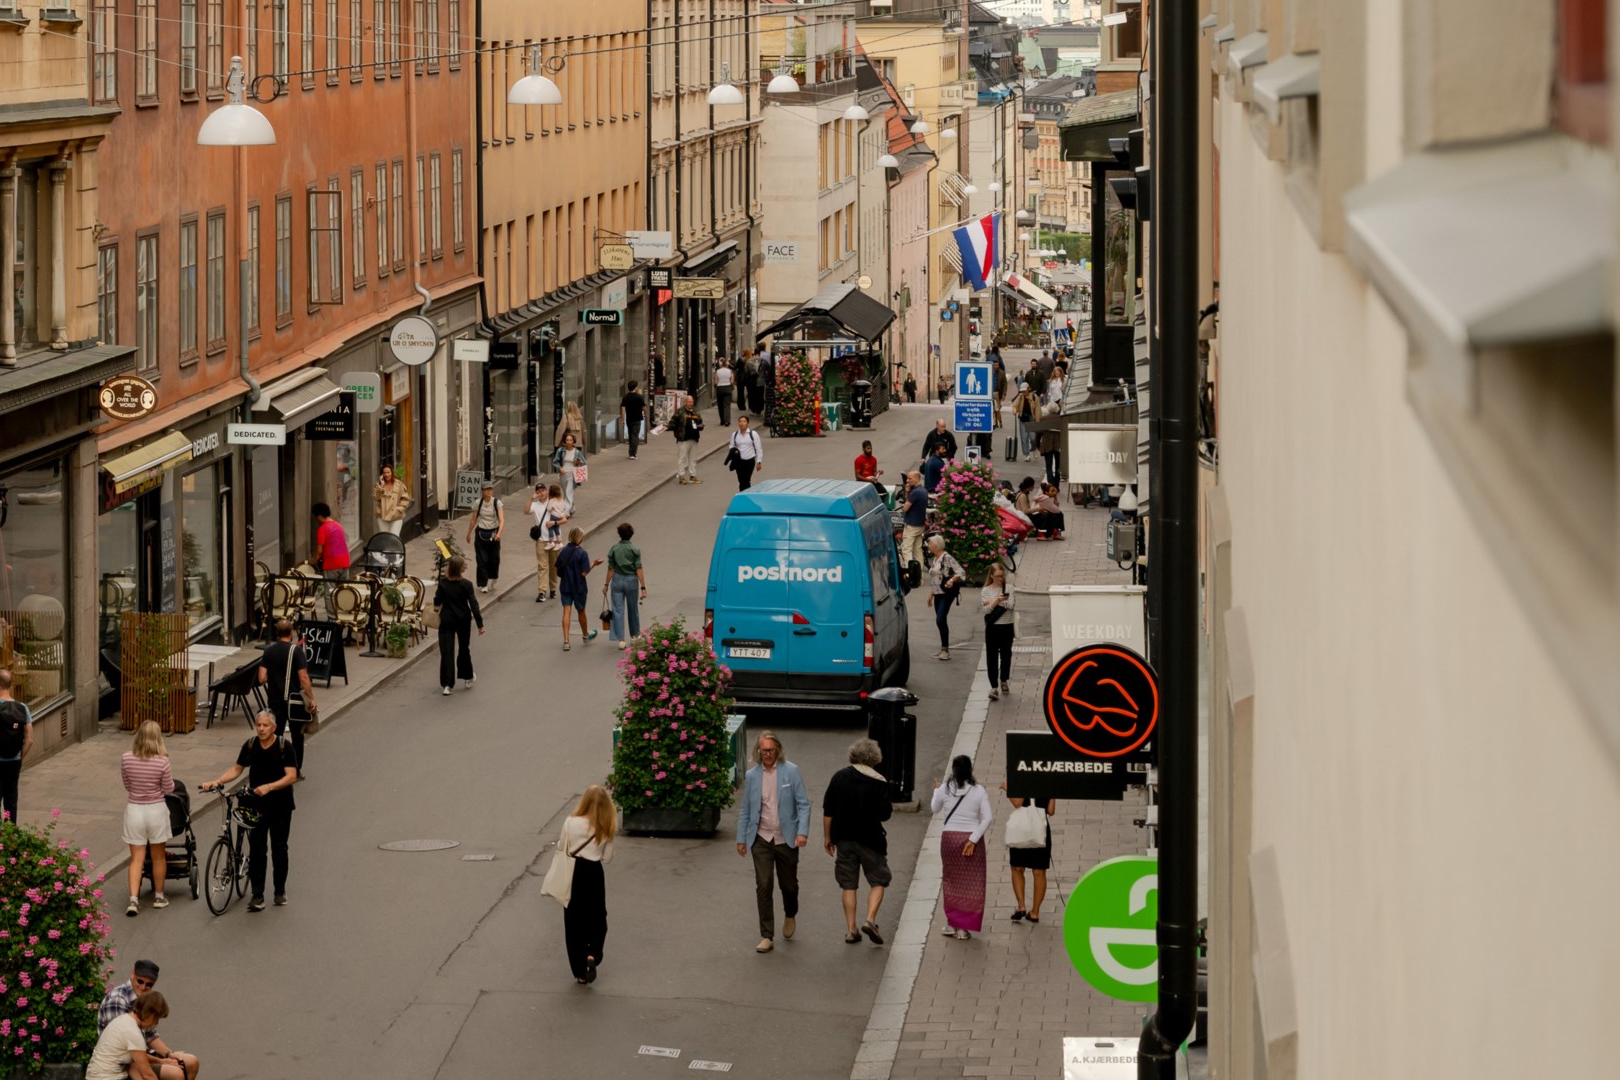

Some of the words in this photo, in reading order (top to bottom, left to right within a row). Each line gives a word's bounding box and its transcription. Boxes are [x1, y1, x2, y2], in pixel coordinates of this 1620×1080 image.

[767, 245, 795, 256] FACE
[589, 313, 616, 321] Normal
[234, 431, 277, 439] DEDICATED.
[460, 476, 481, 485] SAN
[738, 563, 842, 582] postnord
[1062, 624, 1133, 640] WEEKDAY
[733, 648, 749, 656] YTT
[750, 649, 767, 657] 407
[1017, 760, 1113, 774] A.KJÆRBEDE
